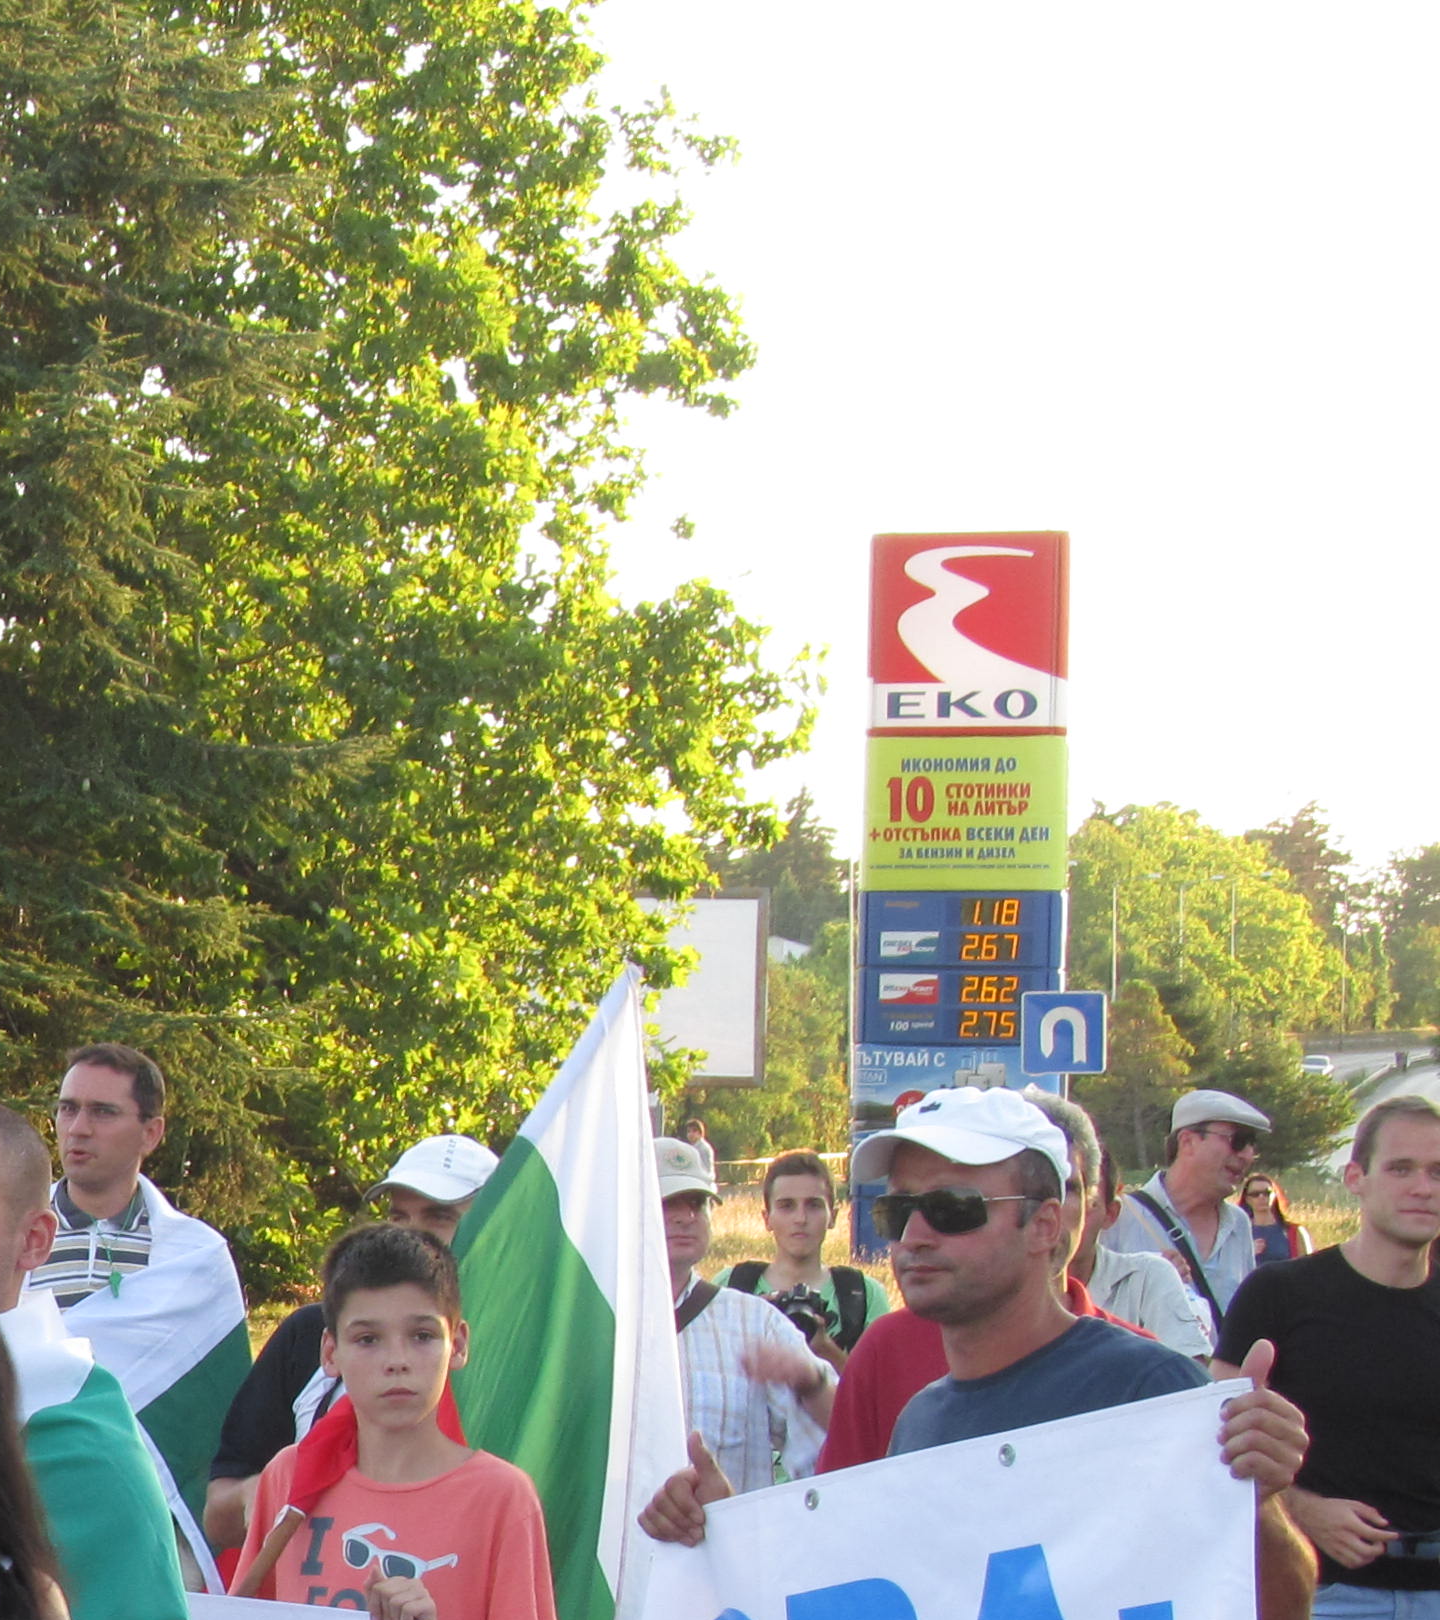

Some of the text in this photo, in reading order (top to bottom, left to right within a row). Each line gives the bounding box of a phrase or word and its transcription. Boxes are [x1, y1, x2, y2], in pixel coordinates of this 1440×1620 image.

[886, 689, 1038, 720] EKO
[901, 757, 1017, 774] ИКОНОМИЯ ДО
[886, 775, 936, 824] 10
[945, 783, 1031, 799] СТОТИНКИ
[947, 800, 1029, 816] НА ЛИТЪР
[966, 826, 1015, 842] ВСЕКИ
[1018, 826, 1050, 843] ДЕН
[899, 847, 914, 859] ЗА
[916, 847, 963, 859] БЕНЗИН
[977, 847, 1016, 860] ДИЗЕЛ
[972, 899, 1020, 926] 1.18
[960, 933, 1019, 961] 2.67
[960, 976, 1018, 1003] 2.62
[959, 1011, 1016, 1038] 2.75
